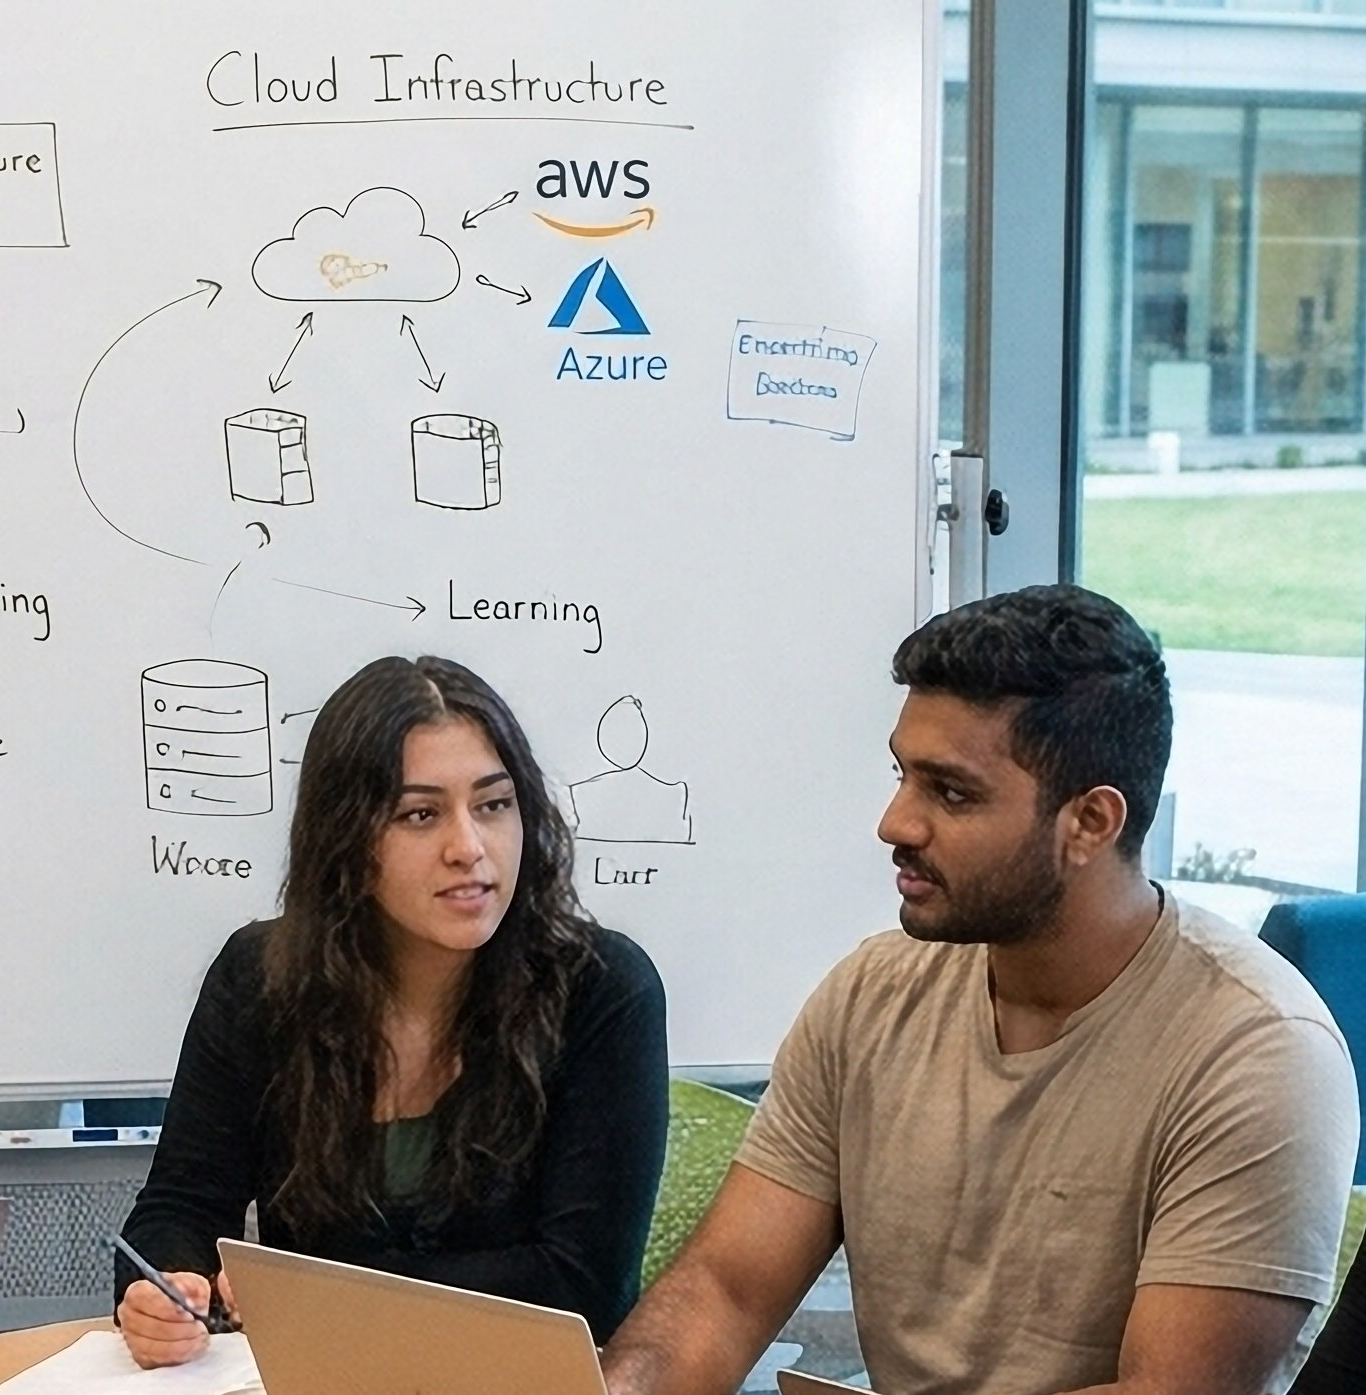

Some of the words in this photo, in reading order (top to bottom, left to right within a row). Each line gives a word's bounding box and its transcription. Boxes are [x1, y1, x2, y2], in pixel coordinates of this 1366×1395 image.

[207, 50, 338, 107] Cloud
[370, 54, 669, 106] Infrastructure
[535, 159, 651, 200] aws
[556, 346, 668, 381] Azure
[448, 579, 603, 654] Learning
